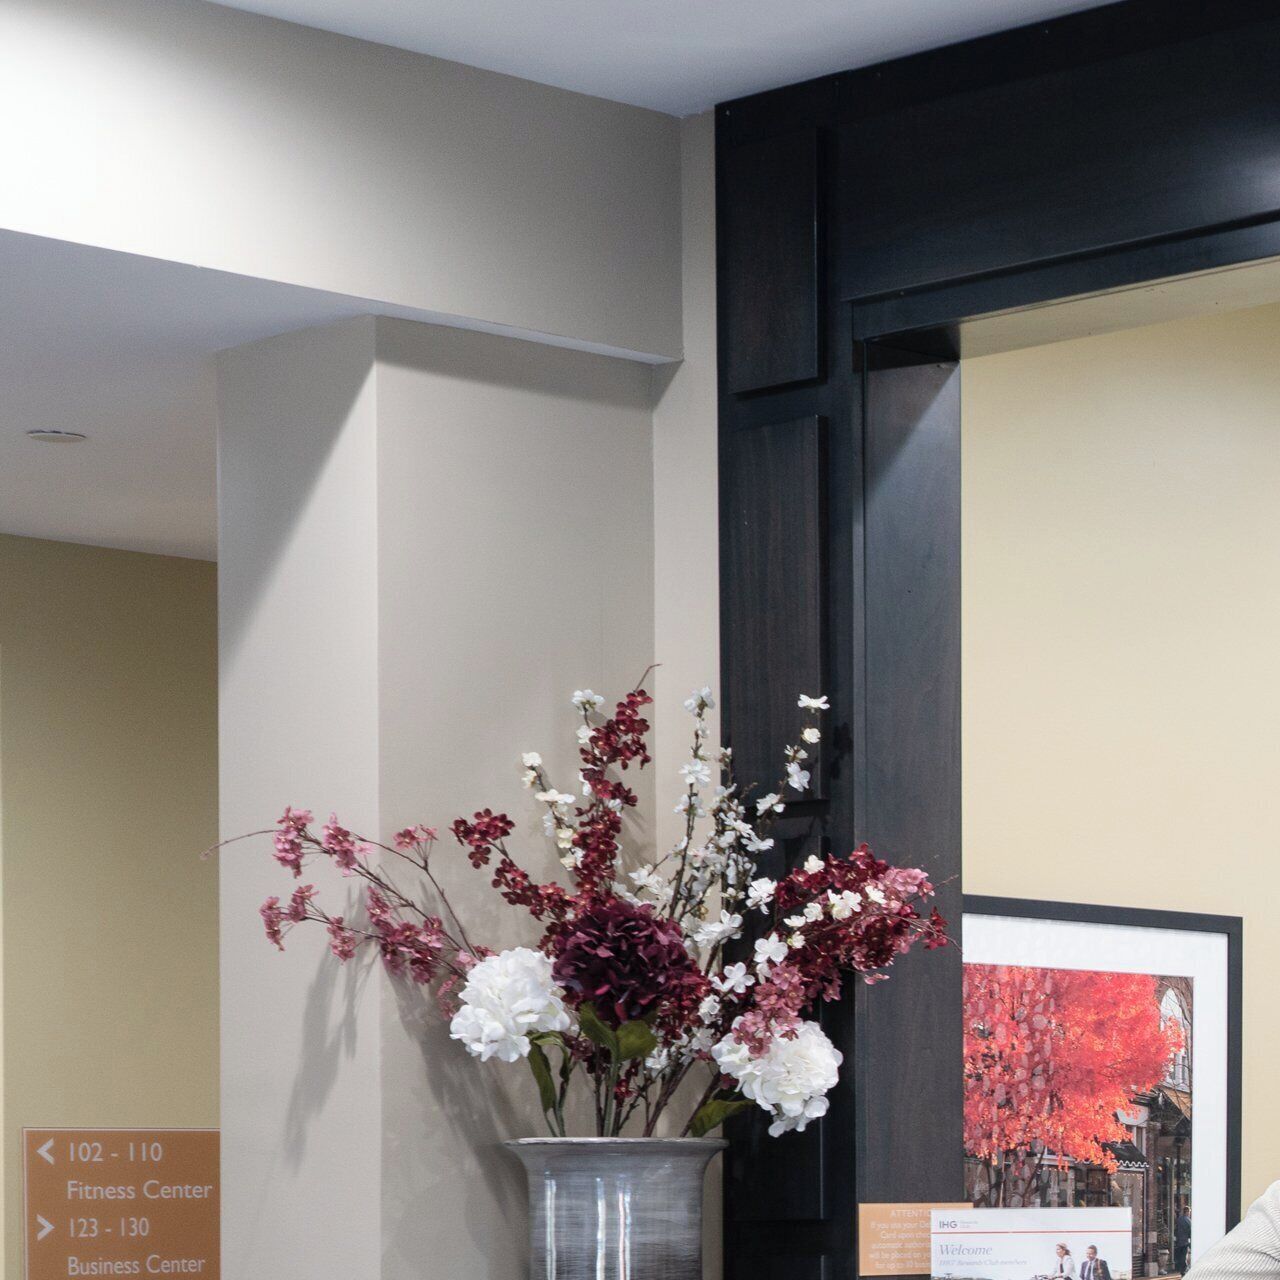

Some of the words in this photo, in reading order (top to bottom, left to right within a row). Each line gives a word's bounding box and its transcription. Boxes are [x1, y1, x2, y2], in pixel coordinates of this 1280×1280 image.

[68, 1142, 104, 1162] 102
[129, 1142, 163, 1162] 110
[67, 1181, 136, 1200] Fitness
[143, 1180, 213, 1199] Center
[69, 1218, 98, 1238] 123
[120, 1217, 149, 1237] 130
[939, 1220, 958, 1229] IHG
[939, 1244, 993, 1256] Welcome
[68, 1256, 139, 1276] Business
[146, 1255, 205, 1274] Center
